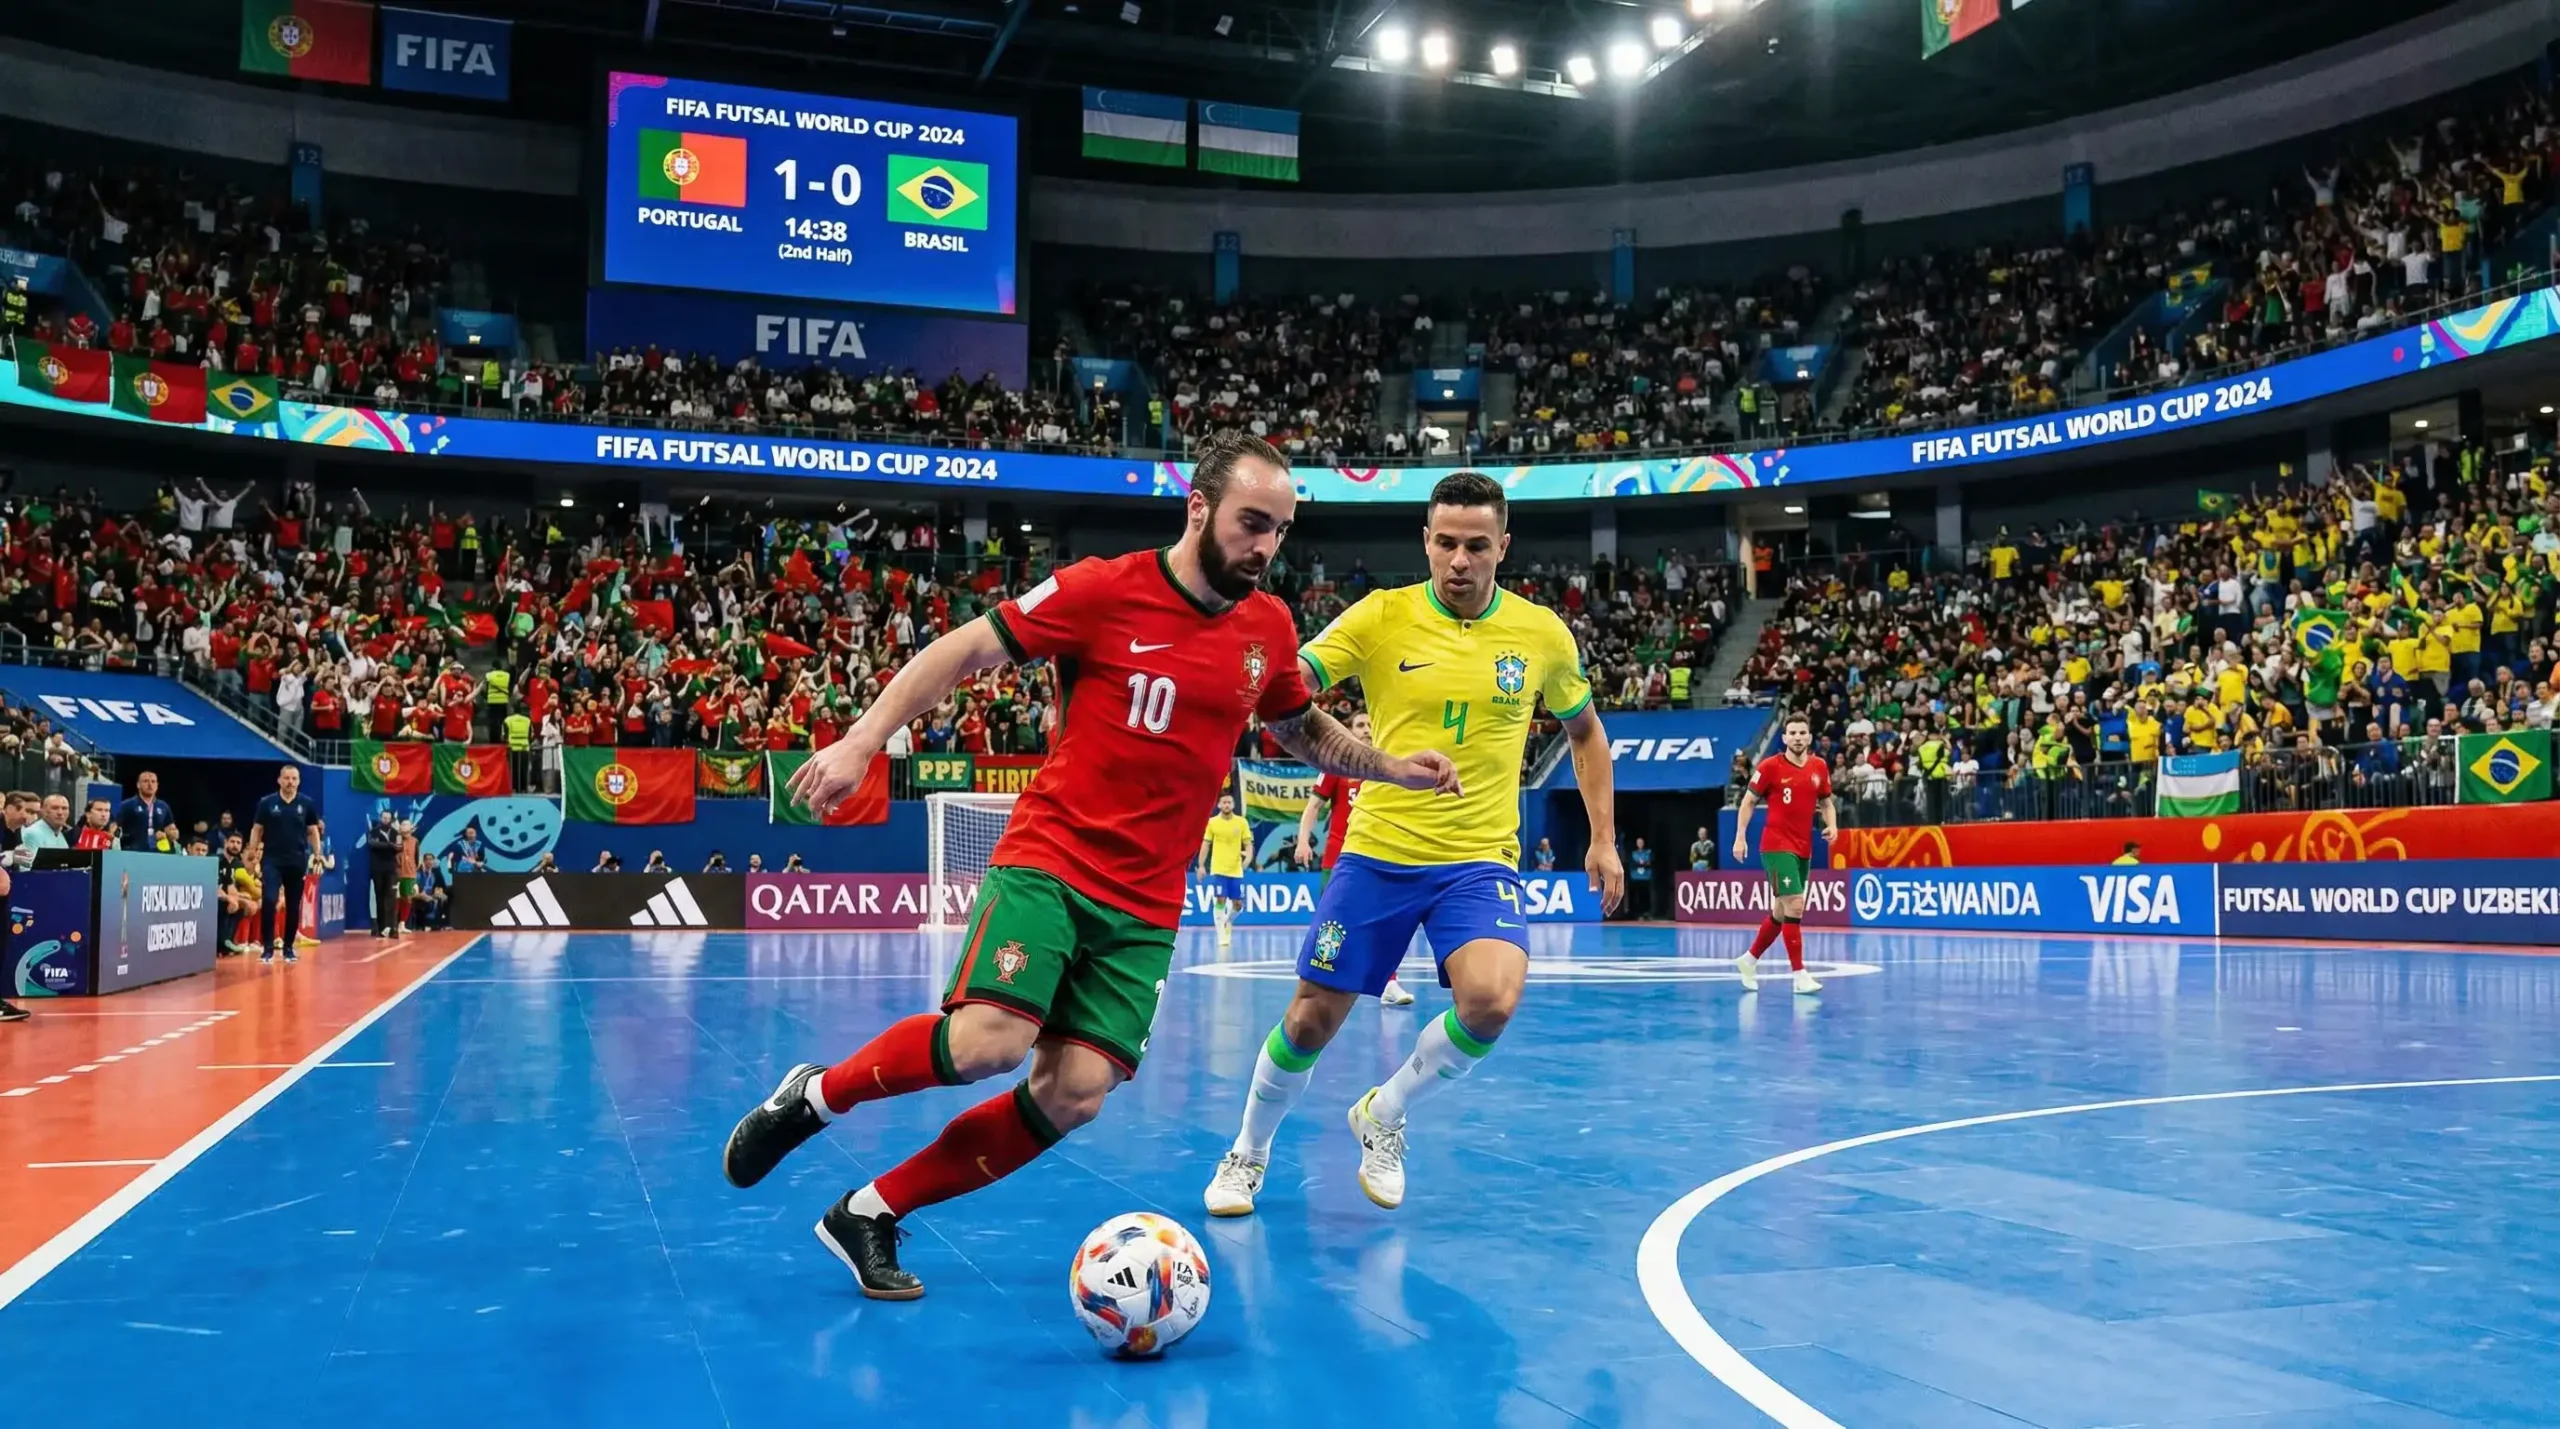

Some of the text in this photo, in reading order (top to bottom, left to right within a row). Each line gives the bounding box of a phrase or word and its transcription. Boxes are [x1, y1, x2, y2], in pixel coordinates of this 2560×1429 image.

[397, 34, 496, 75] FIFA
[667, 98, 964, 145] FIFA FUTSAL WORLD CUP 2024
[639, 208, 742, 232] PORTUGAL
[786, 218, 847, 242] 14:38
[779, 244, 852, 265] (2nd Half)
[905, 232, 968, 252] BRASIL
[756, 315, 866, 359] FIFA
[1913, 378, 2272, 463] FIFA FUTSAL WORLD CUP 2024
[597, 436, 997, 480] FIFA FUTSAL WORLD CUP 2024
[38, 695, 195, 726] FIFA
[1128, 673, 1176, 734] 10
[1443, 699, 1469, 745] 4
[1610, 738, 1714, 761] FIFA
[1783, 787, 1792, 804] 3
[752, 884, 979, 920] QATAR AIRW
[1196, 884, 1316, 913] WNDA
[1496, 881, 1521, 916] 4
[1520, 879, 1574, 915] SA
[1678, 881, 1846, 915] QATAR AIAYS
[2080, 875, 2180, 924] VISA
[2224, 887, 2560, 914] FUTSAL WORLD CUP UZBEKI
